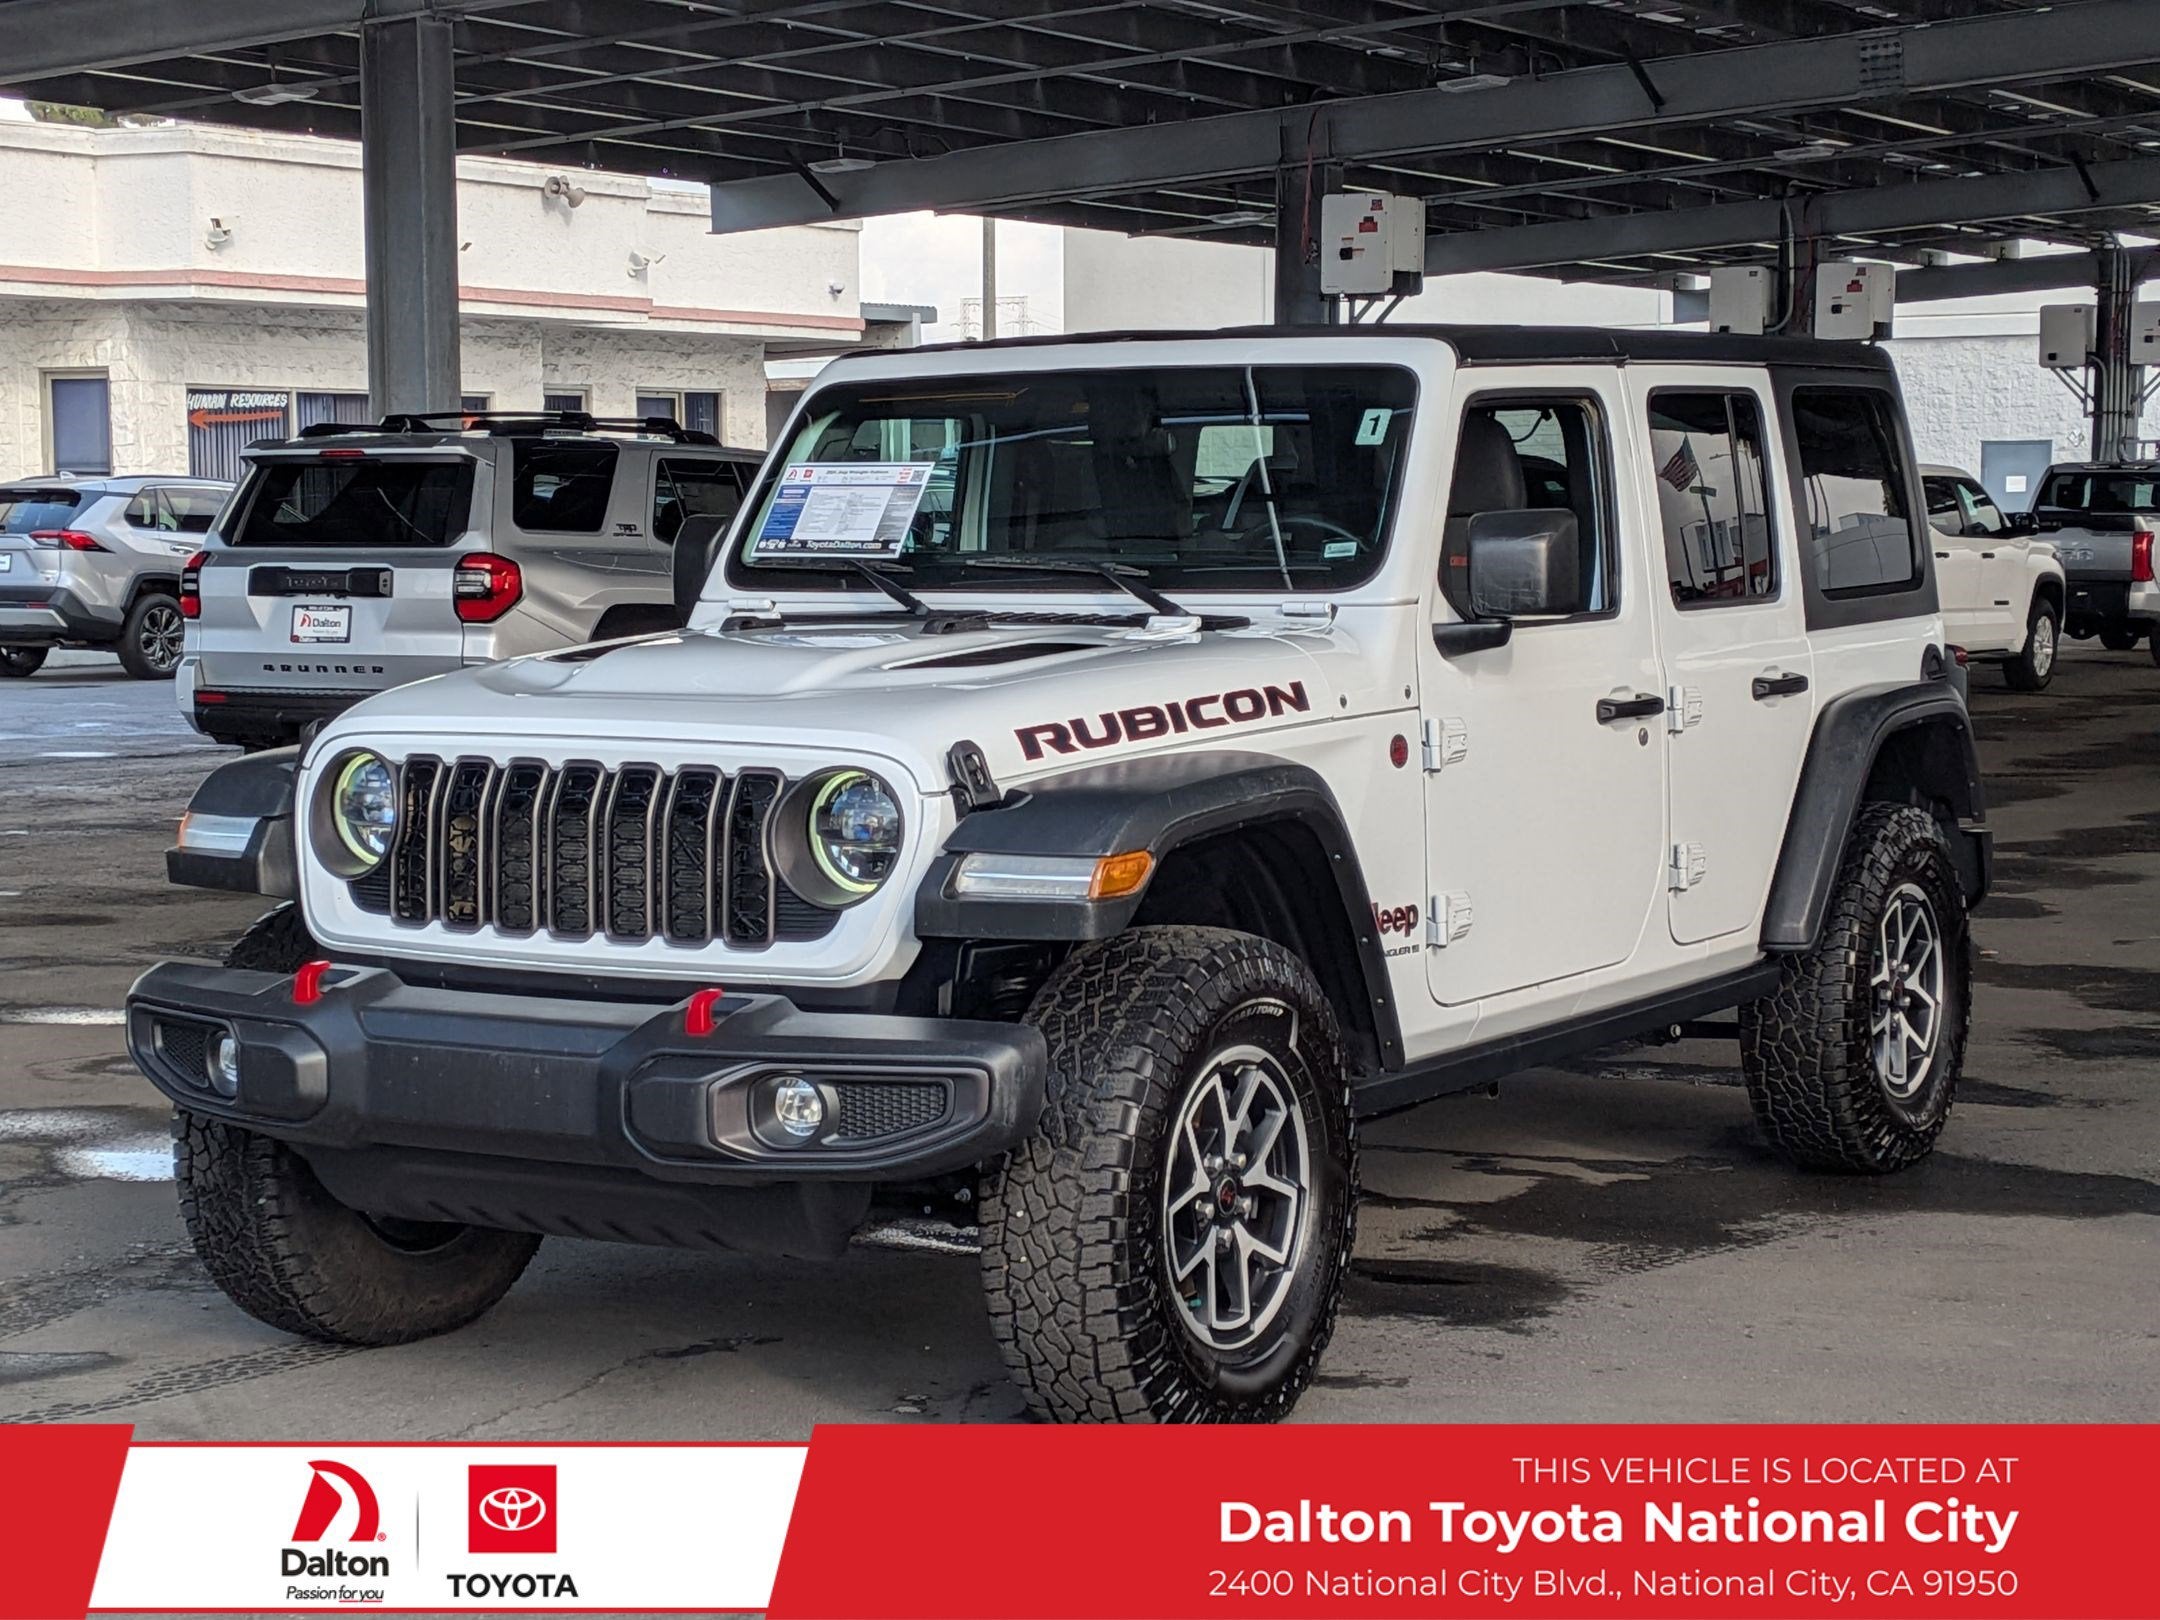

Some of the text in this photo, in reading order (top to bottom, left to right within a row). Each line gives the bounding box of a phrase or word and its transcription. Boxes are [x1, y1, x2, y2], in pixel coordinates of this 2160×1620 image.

[187, 393, 288, 409] HUMAN RESOURCES
[1369, 414, 1381, 436] 1
[312, 618, 341, 628] Dalton
[263, 664, 384, 674] 4RUNNER
[1013, 680, 1311, 761] RUBICON
